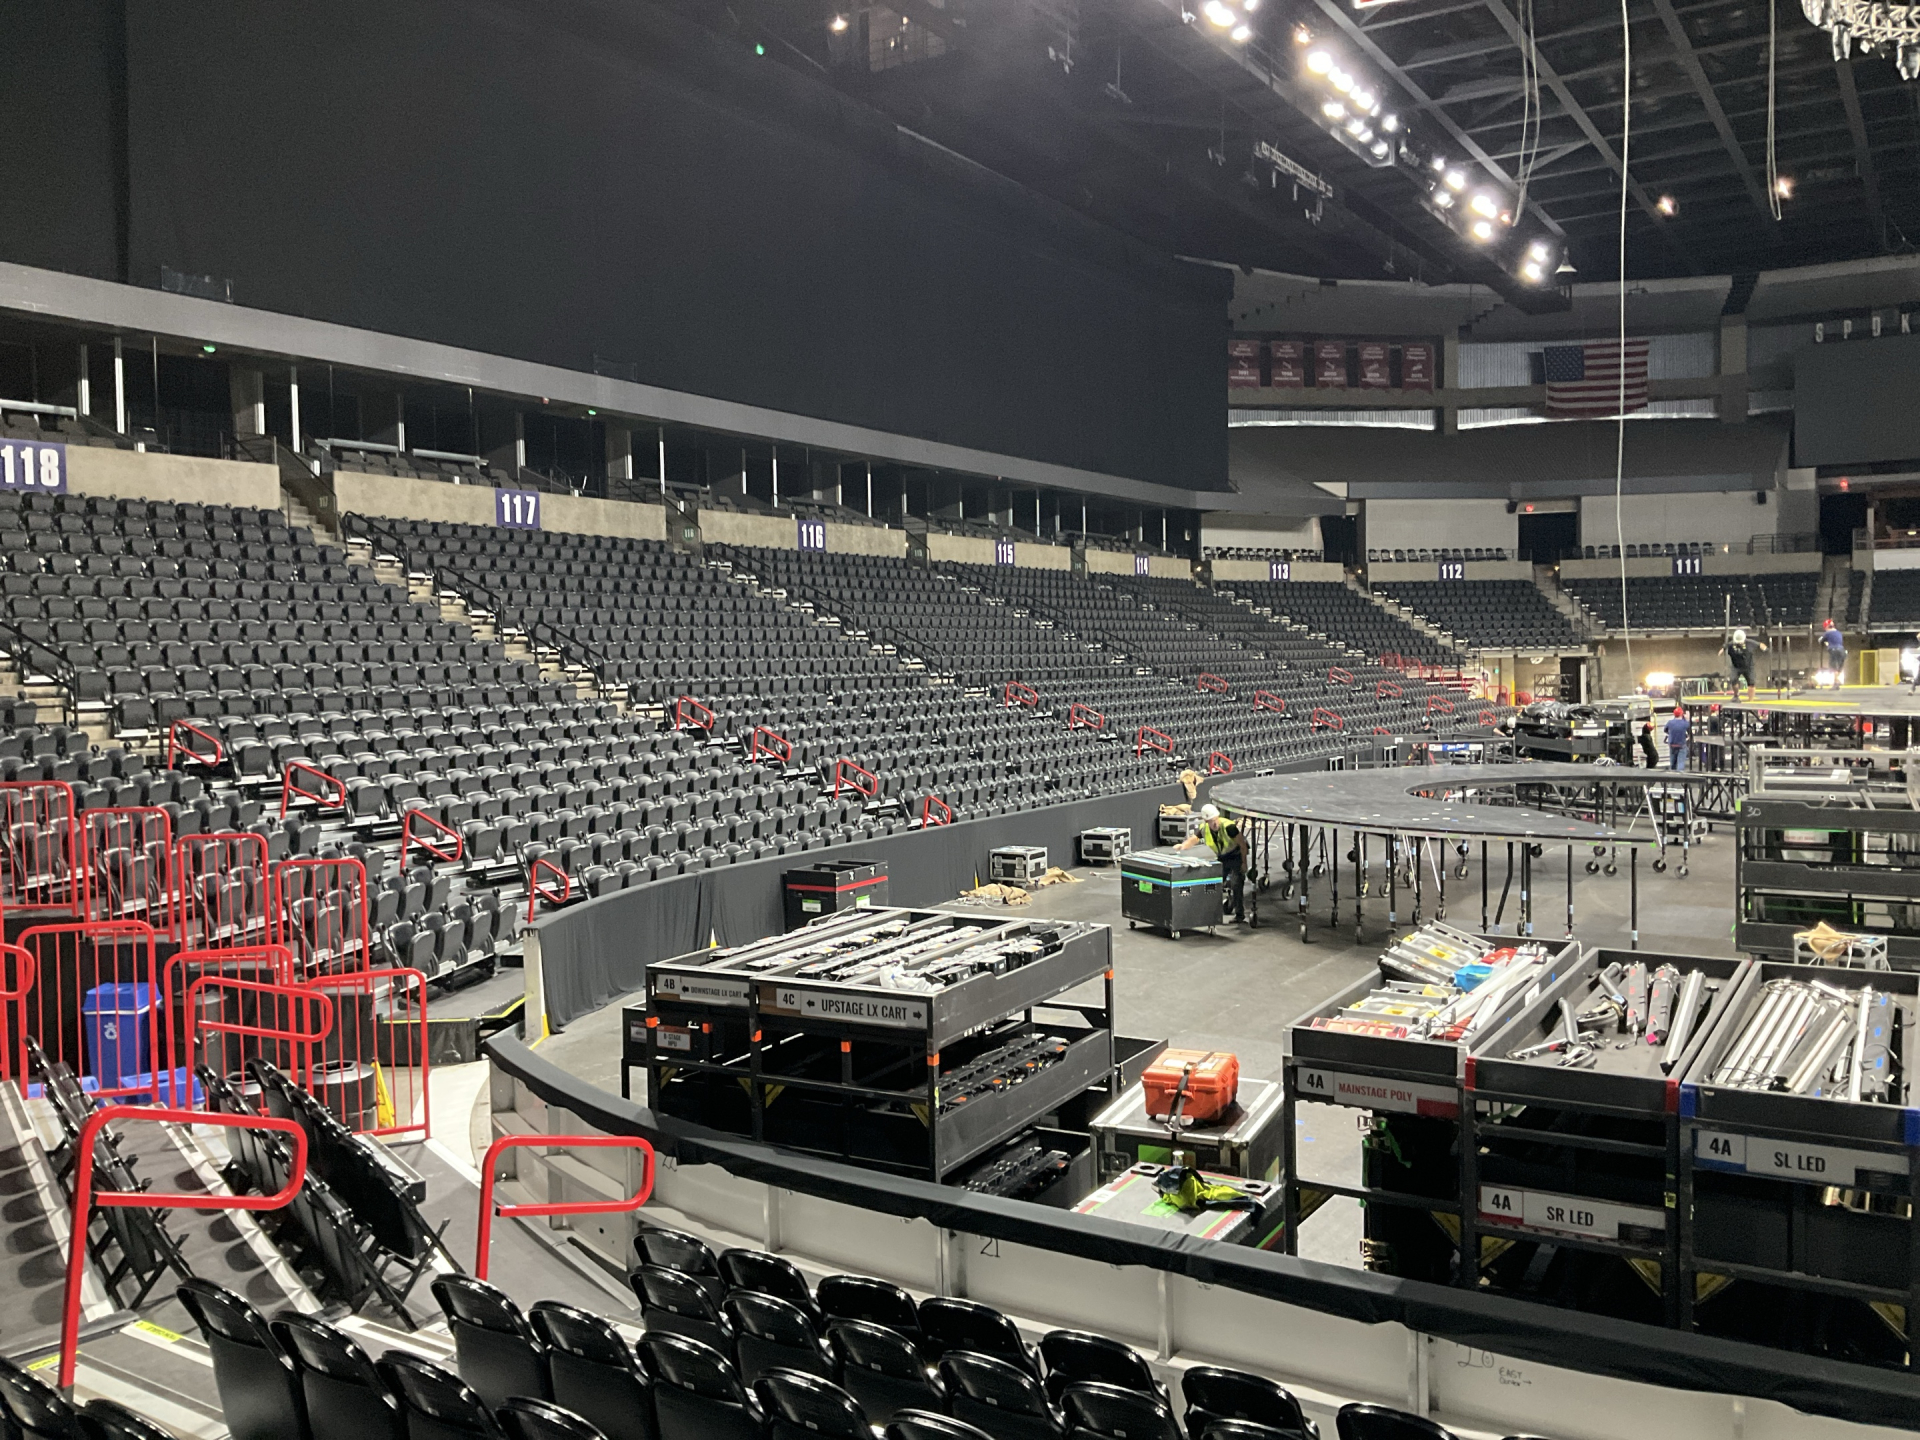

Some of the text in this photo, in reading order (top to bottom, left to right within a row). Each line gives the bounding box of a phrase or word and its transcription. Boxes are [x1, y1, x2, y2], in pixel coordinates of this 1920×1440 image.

[1, 445, 60, 487] 118
[501, 493, 536, 525] 117
[801, 523, 825, 549] 116
[998, 543, 1014, 564] 115
[1136, 556, 1148, 575] 114
[1271, 563, 1289, 580] 113
[1441, 563, 1463, 580] 112
[1676, 558, 1700, 574] 111
[663, 978, 676, 990] 4B
[690, 986, 721, 997] DOWNSTAGE
[728, 990, 742, 999] CART
[782, 993, 908, 1021] 4C UPSTAGE LX CART
[1306, 1073, 1413, 1102] 4A MAINSTAGE POLY
[1709, 1137, 1826, 1173] 4A SL LED
[1491, 1193, 1594, 1227] 4A SR LED
[1499, 1366, 1523, 1380] EAST
